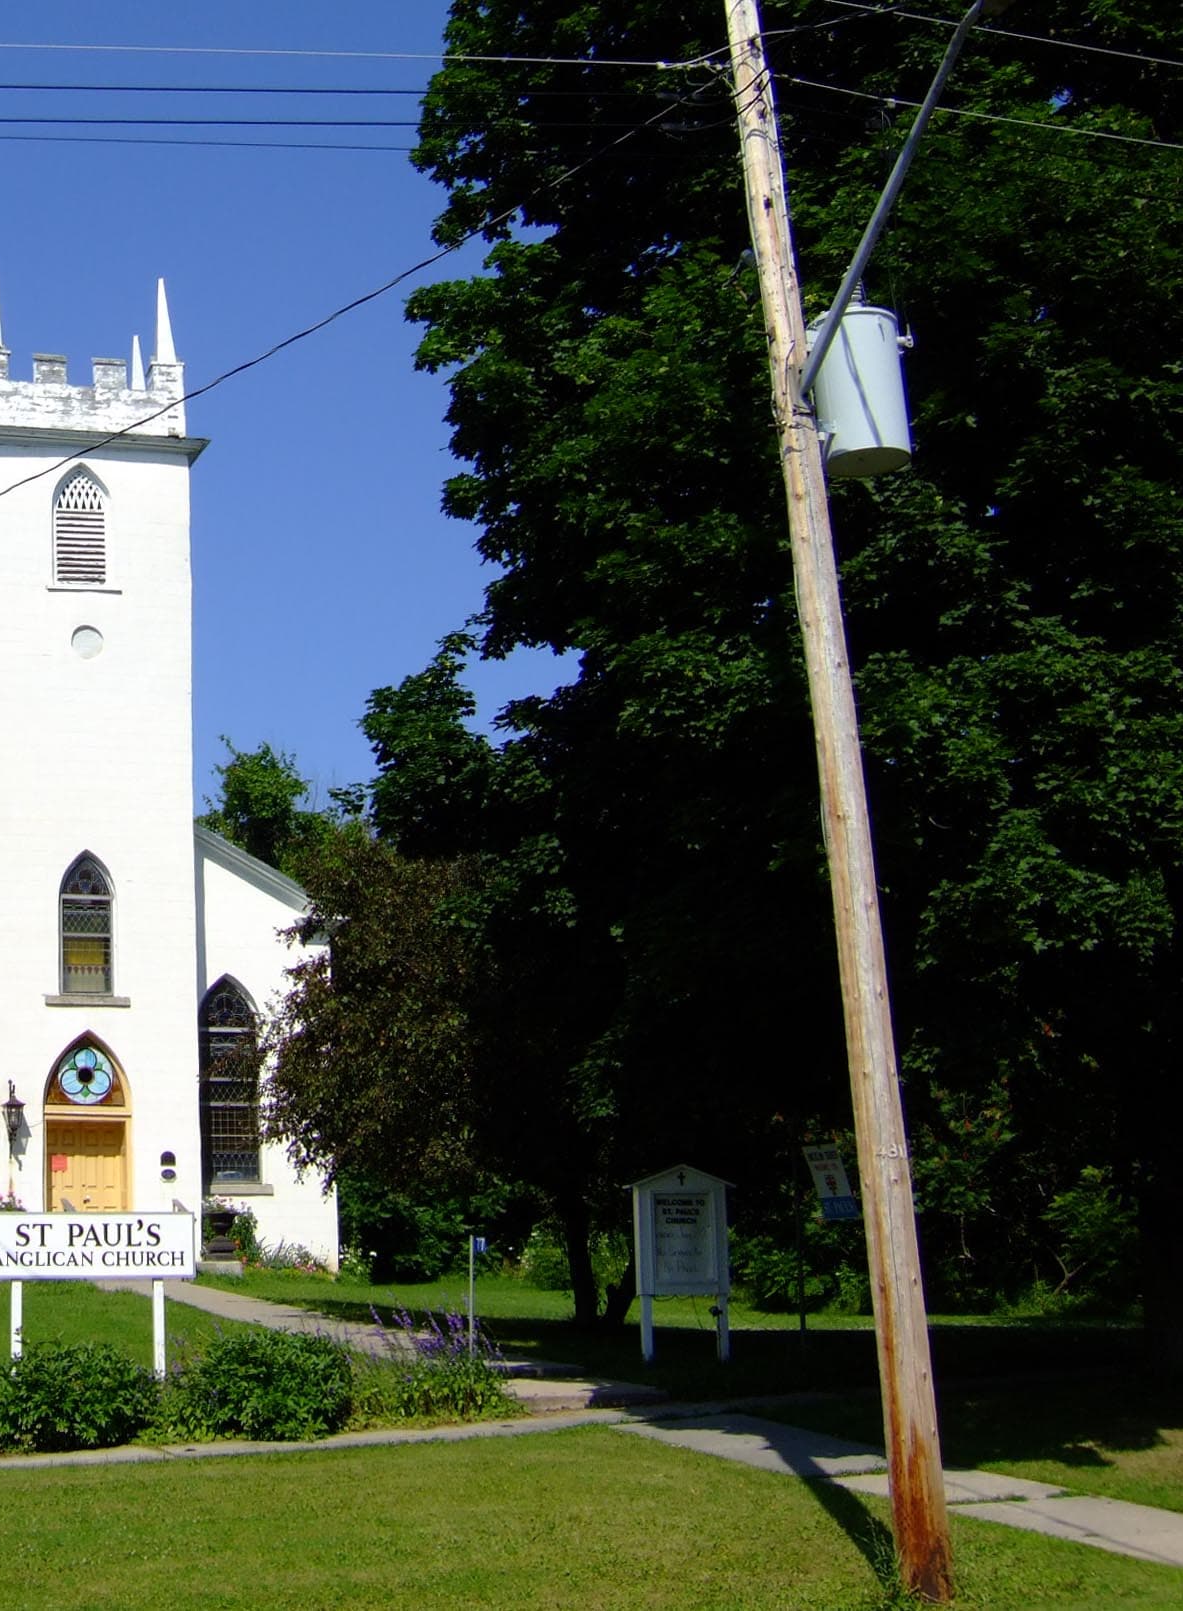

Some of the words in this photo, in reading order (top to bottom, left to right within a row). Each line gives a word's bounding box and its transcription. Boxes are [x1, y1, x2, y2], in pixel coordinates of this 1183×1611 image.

[15, 1223, 53, 1247] ST
[68, 1219, 161, 1247] PAUL'S
[101, 1251, 185, 1267] CHURCH
